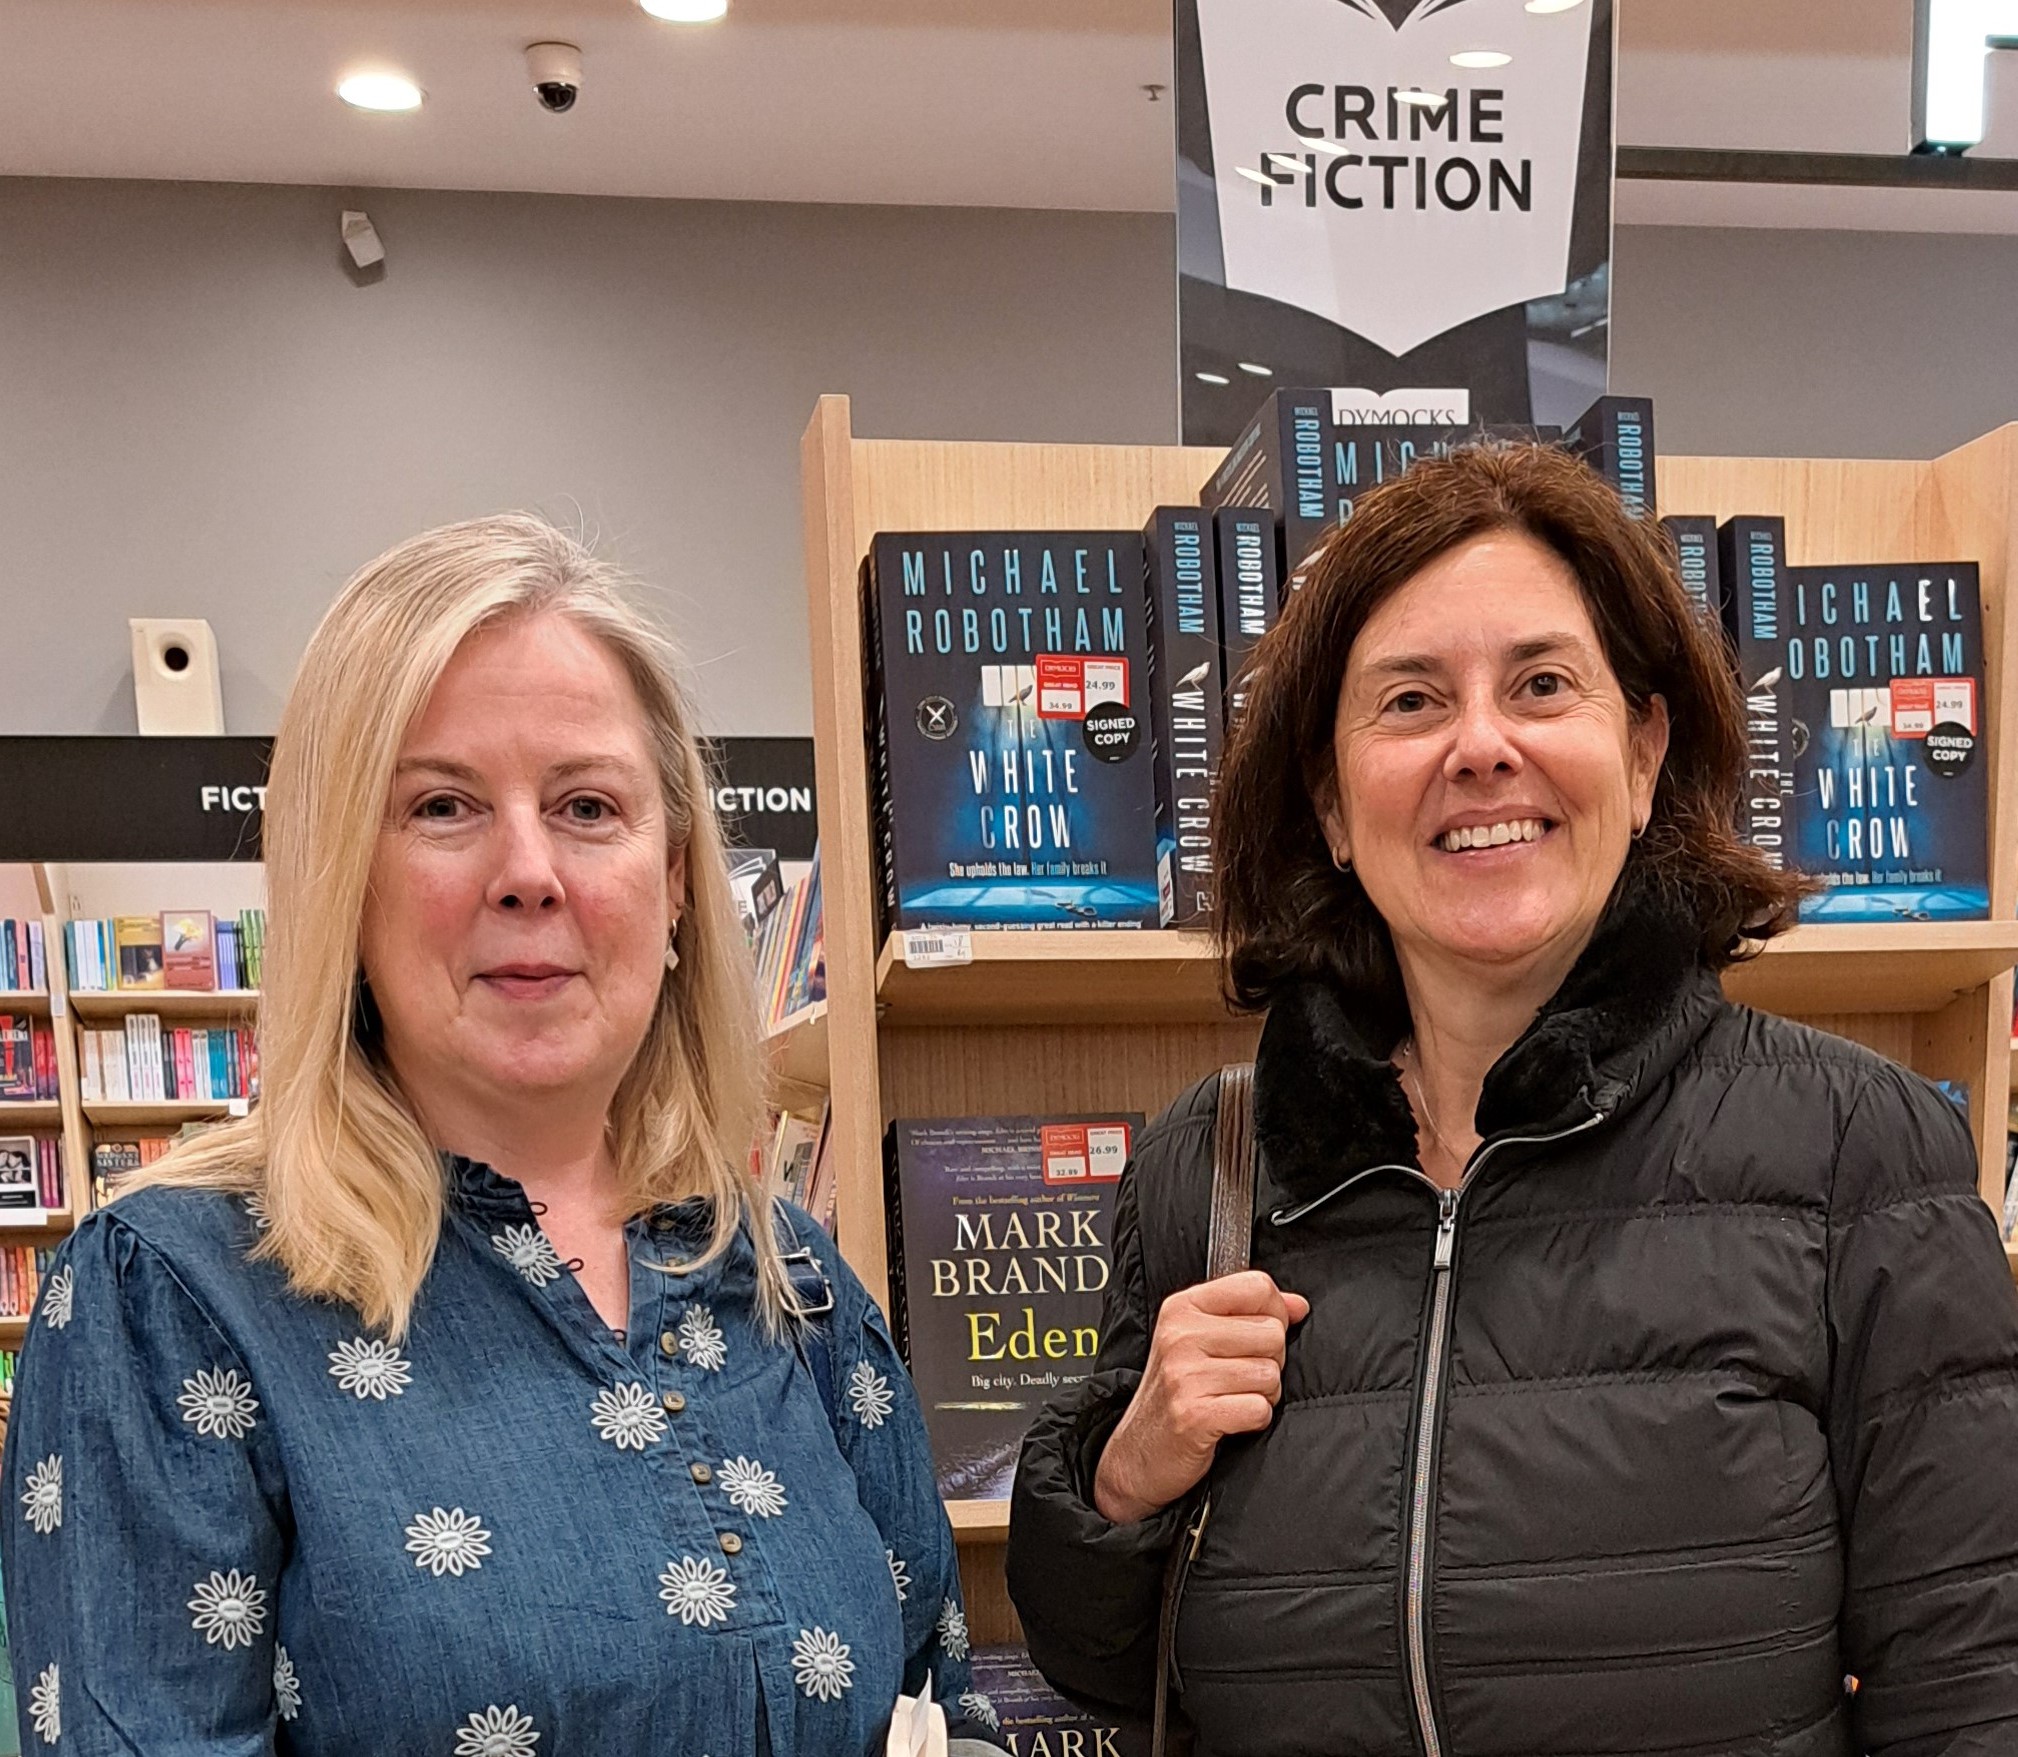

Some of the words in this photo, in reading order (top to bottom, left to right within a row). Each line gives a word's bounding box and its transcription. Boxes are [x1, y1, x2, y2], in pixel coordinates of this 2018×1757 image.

[1286, 84, 1503, 142] CRIME
[1260, 153, 1531, 211] FICTION
[1338, 409, 1456, 425] DYMOCKS
[1294, 419, 1325, 518] ROBOTHAM
[902, 549, 1123, 596] MICHAEL
[1174, 534, 1205, 633] ROBOTHAM
[1235, 535, 1266, 635] ROBOTHAM
[1680, 546, 1707, 613] ROBOT
[1750, 544, 1778, 640] ROBOTHAM
[1798, 579, 1963, 626] ICHAEL
[906, 607, 1125, 654] ROBOTHAM
[1788, 633, 1964, 680] OBOTHAM
[1085, 680, 1116, 691] 24.99
[1086, 717, 1136, 732] SIGNED
[1094, 732, 1131, 746] COPY
[1171, 691, 1208, 779] WHITE
[1746, 694, 1780, 779] WHITE
[1927, 736, 1974, 748] SIGNED
[969, 749, 1079, 794] WHITE
[1932, 750, 1967, 762] COPY
[201, 786, 268, 811] FICT
[708, 787, 812, 812] ICTION
[1780, 772, 1794, 795] THE
[1818, 765, 1918, 809] WHITE
[980, 804, 1072, 849] CROW
[1177, 797, 1214, 873] CROW
[1827, 817, 1910, 860] CROW
[949, 861, 964, 877] She
[1072, 861, 1099, 876] breaks
[1089, 1145, 1118, 1155] 26.99
[952, 1209, 1104, 1251] MARK
[930, 1254, 1110, 1297] BRAND
[964, 1307, 1099, 1362] Eden
[971, 1373, 990, 1390] Big
[1020, 1371, 1060, 1388] Deadly
[1062, 1375, 1086, 1385] secr
